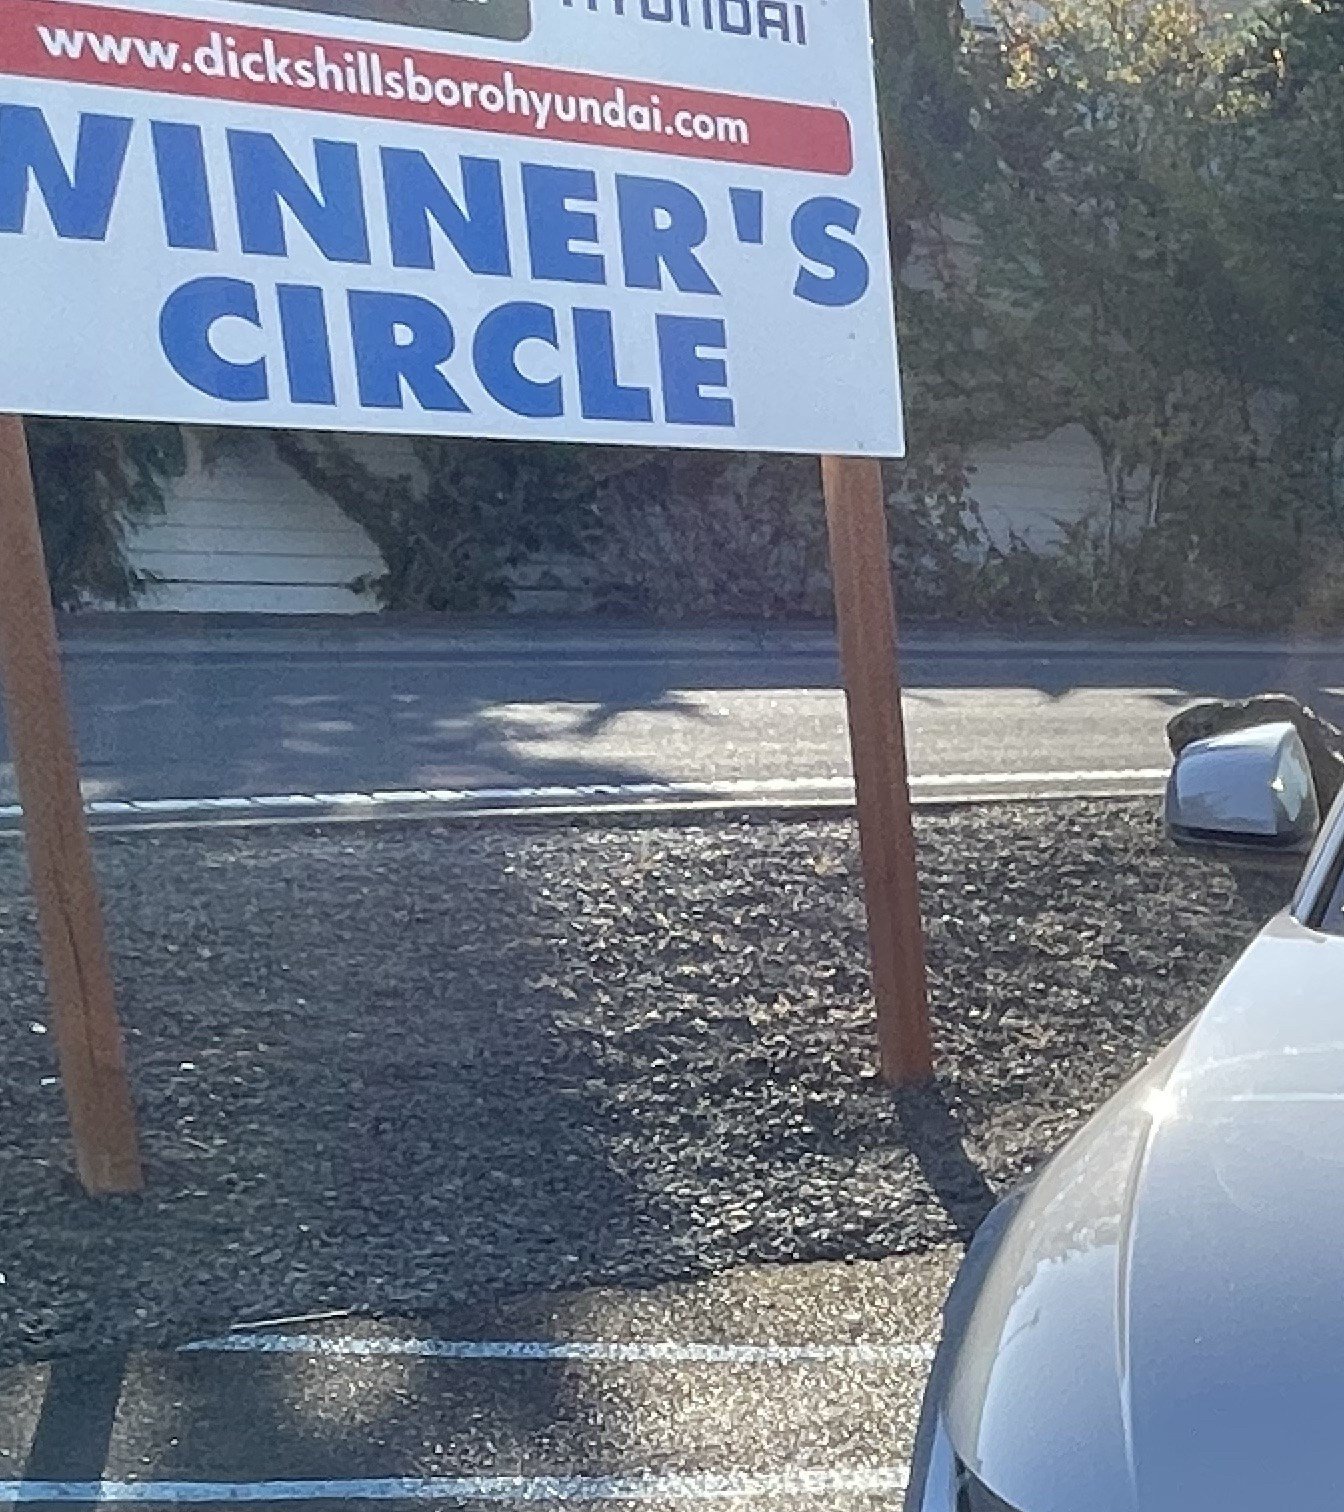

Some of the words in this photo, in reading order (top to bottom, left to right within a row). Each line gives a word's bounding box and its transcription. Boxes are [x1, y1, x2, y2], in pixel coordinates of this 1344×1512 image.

[37, 22, 750, 146] www.dickshillsborohyundai.com
[561, 0, 807, 45] UNDAI
[158, 276, 736, 429] CIRCLE
